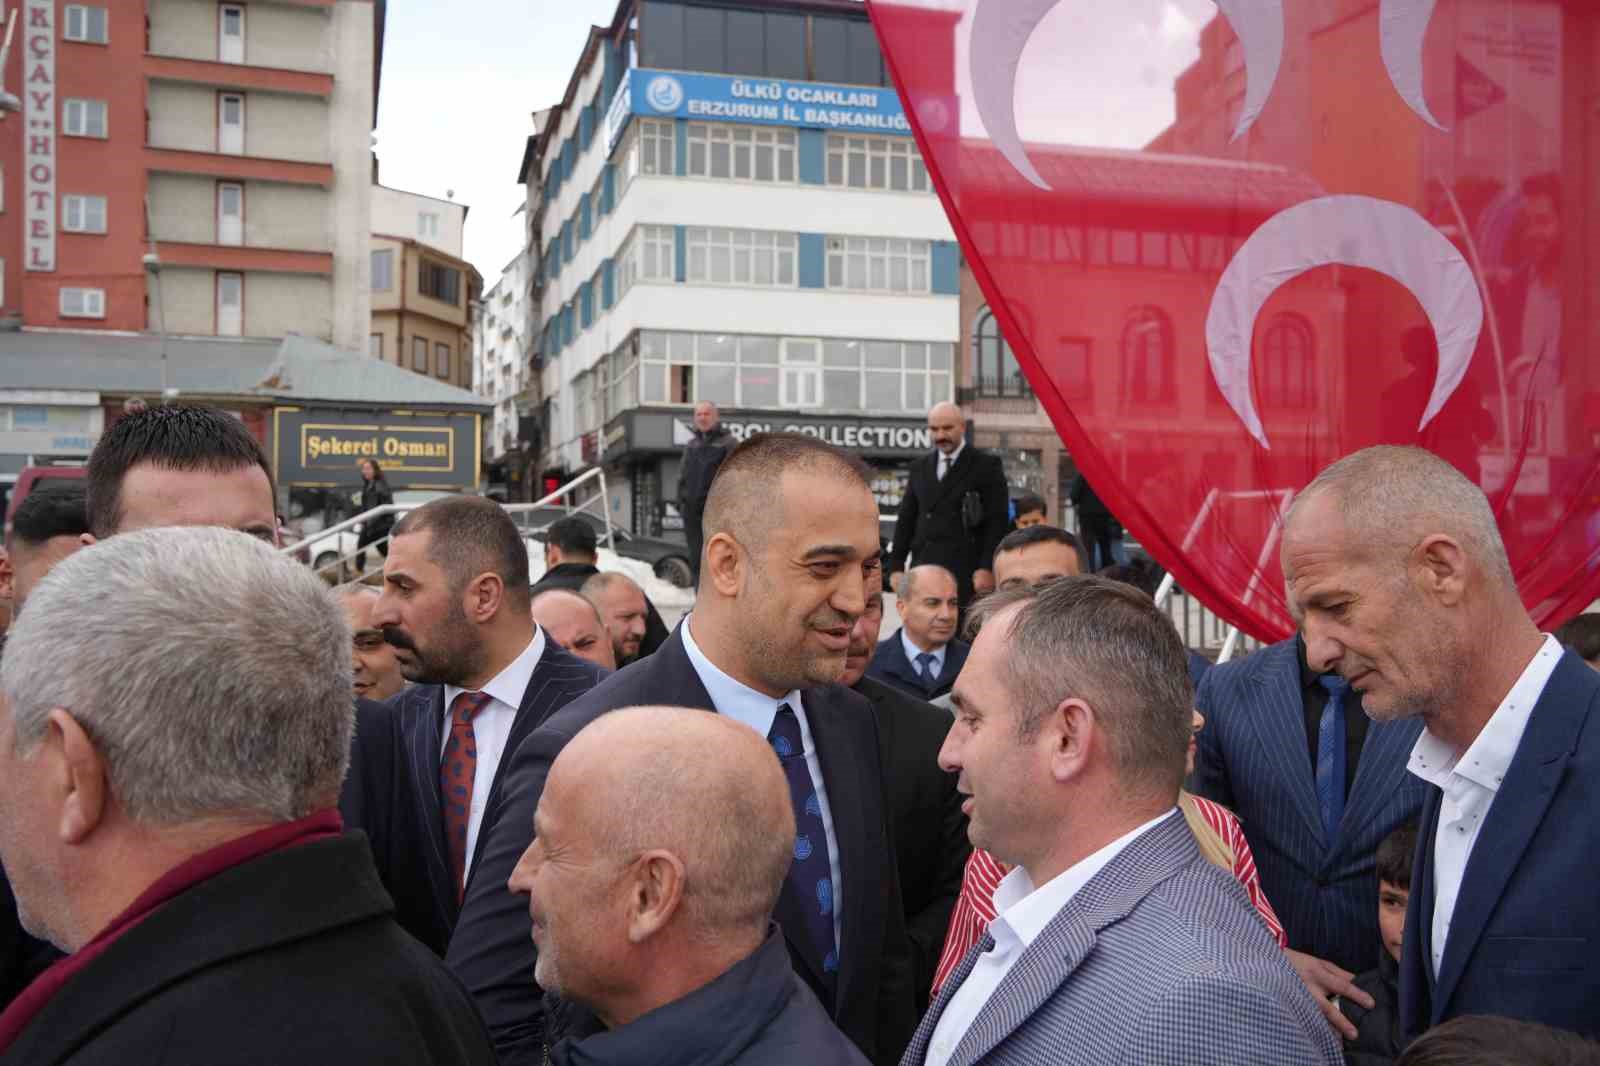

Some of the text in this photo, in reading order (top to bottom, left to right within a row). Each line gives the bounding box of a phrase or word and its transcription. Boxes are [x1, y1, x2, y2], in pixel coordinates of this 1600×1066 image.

[731, 80, 878, 107] ÜLKÜ OCAKLARI
[687, 99, 911, 130] ERZURUM İL BAŞKANLIĞ
[29, 4, 51, 267] KÇAY HOTEL
[308, 434, 447, 459] Şekerci Osman
